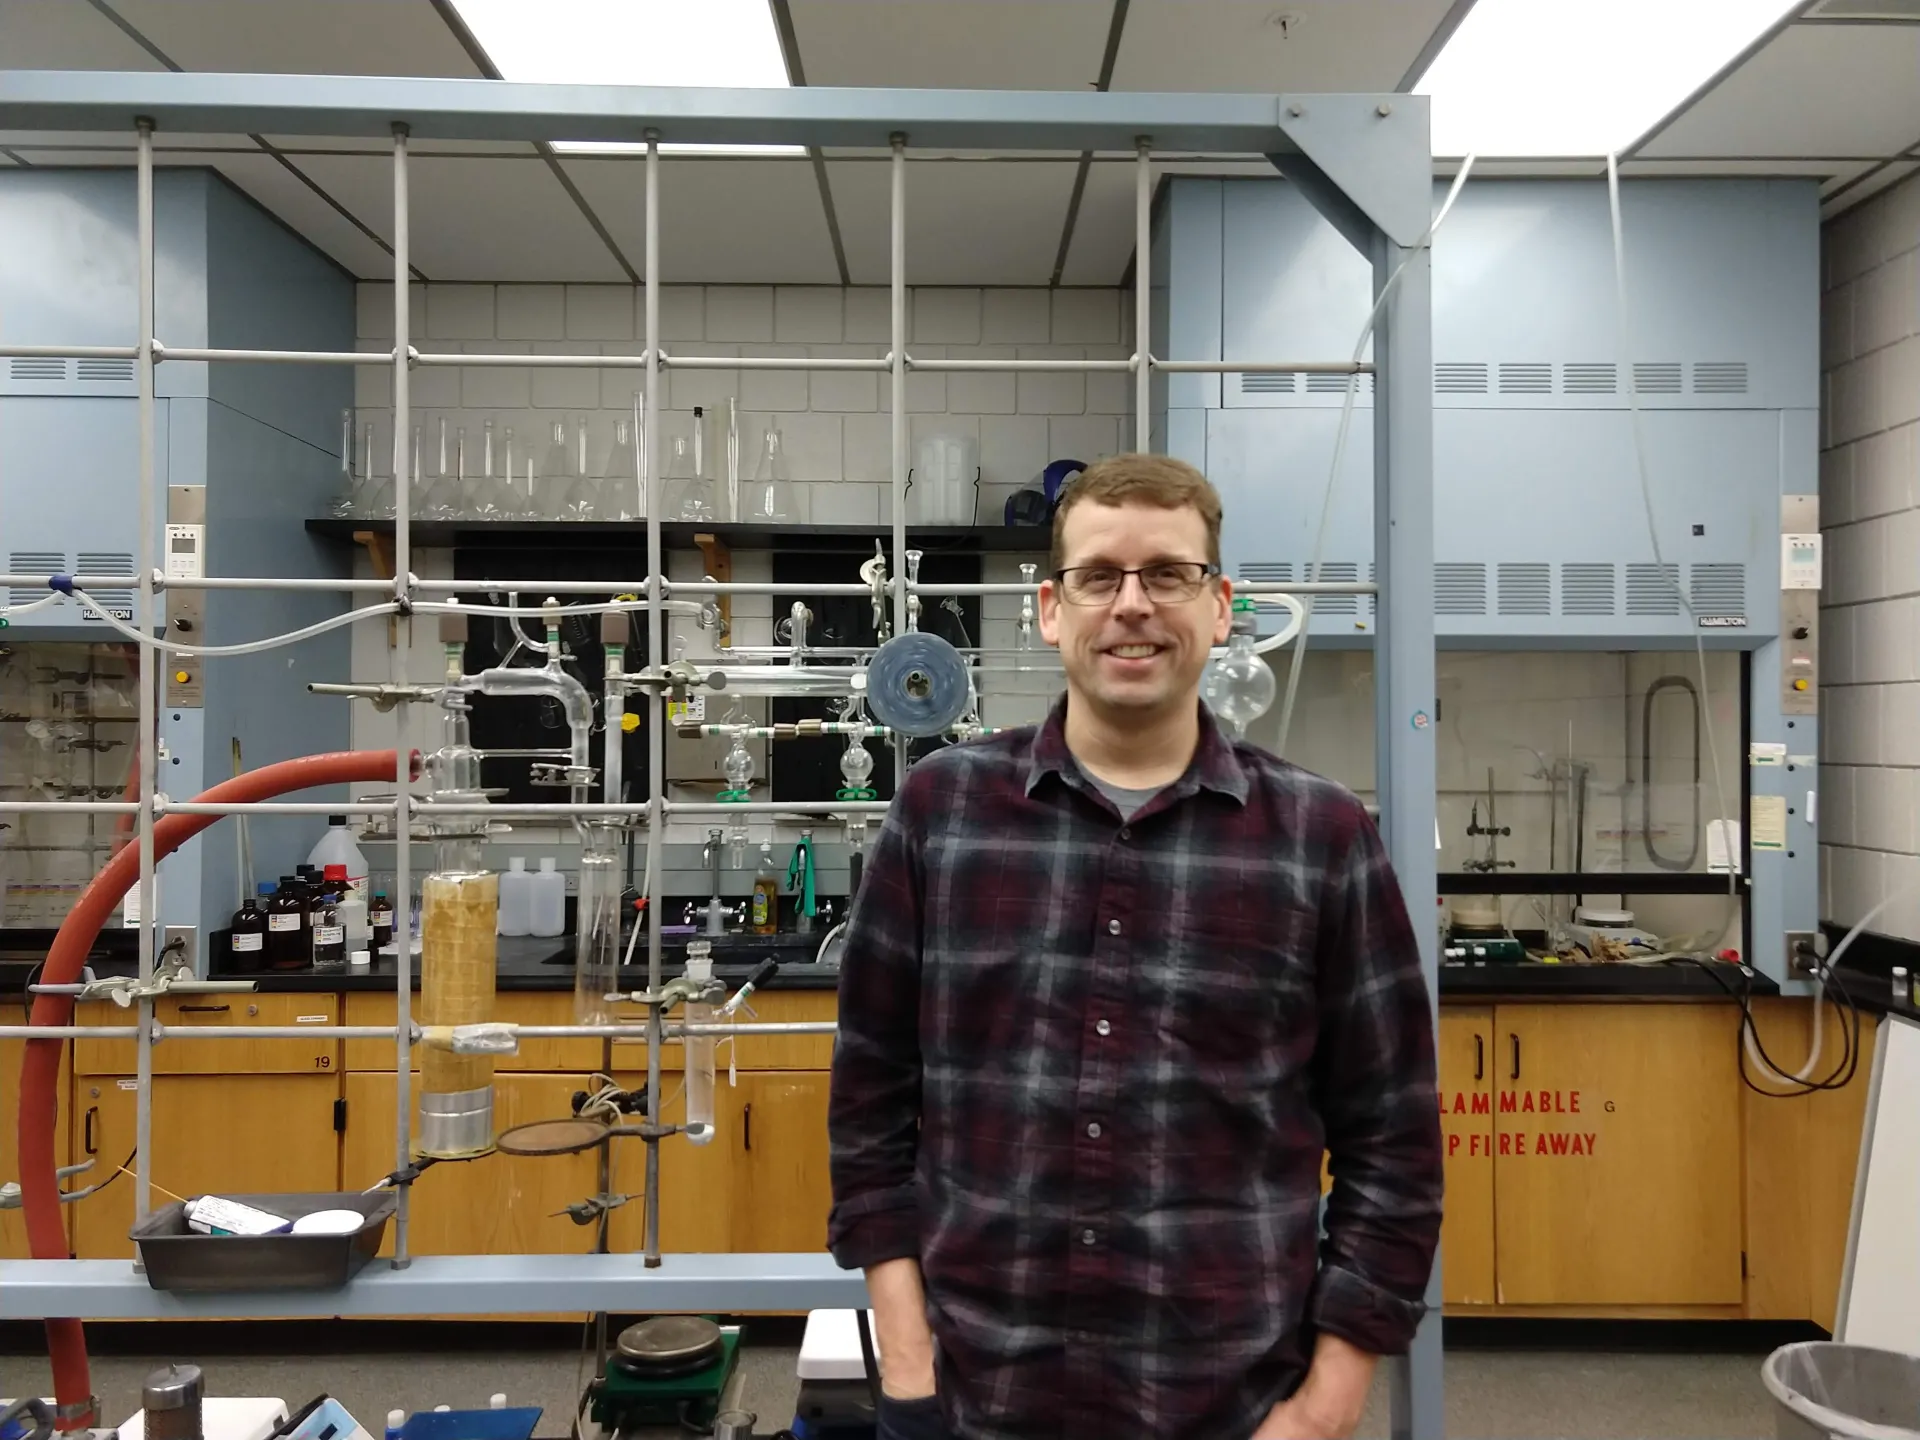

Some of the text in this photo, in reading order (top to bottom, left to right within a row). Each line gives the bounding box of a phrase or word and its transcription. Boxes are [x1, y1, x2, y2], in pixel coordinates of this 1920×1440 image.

[314, 1055, 330, 1068] 19
[1438, 1090, 1581, 1115] LAMMABLE
[1604, 1100, 1616, 1113] G
[1470, 1132, 1526, 1157] FIRE
[1535, 1132, 1597, 1156] AWAY
